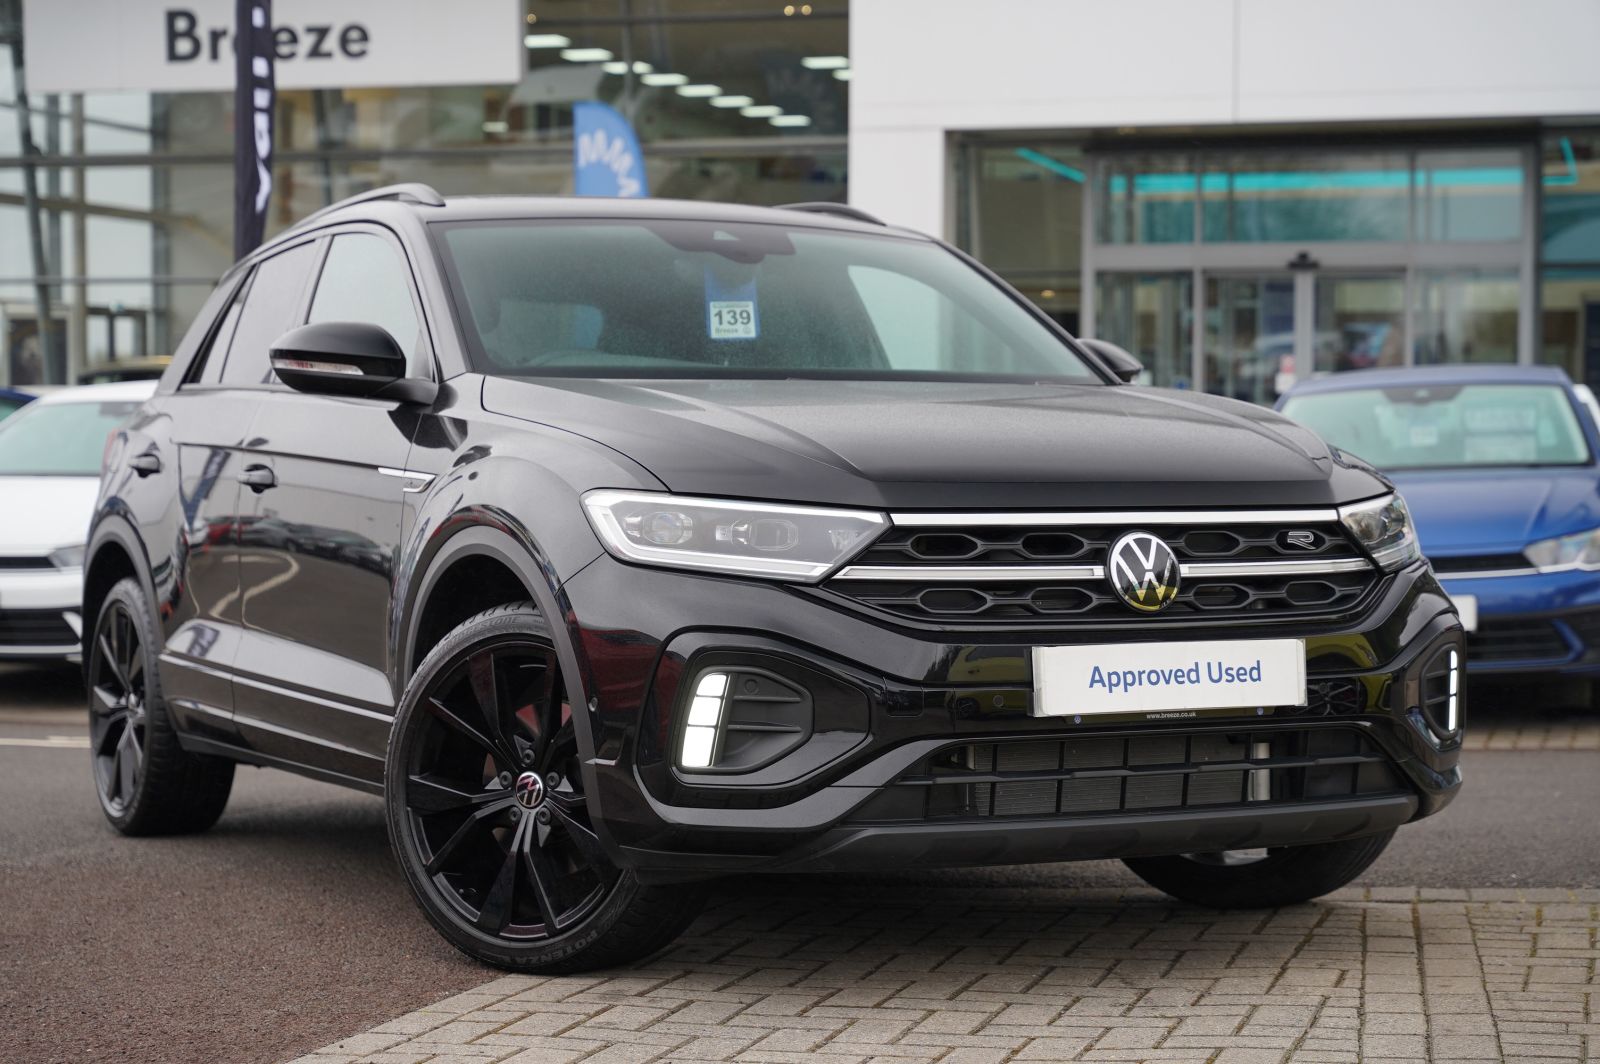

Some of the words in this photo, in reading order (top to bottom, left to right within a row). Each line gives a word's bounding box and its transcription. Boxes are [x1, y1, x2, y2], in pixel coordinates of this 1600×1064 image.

[166, 9, 370, 62] Breze
[714, 309, 752, 326] 139
[1088, 661, 1201, 693] Approved
[1206, 660, 1262, 684] Used
[1146, 711, 1197, 719] www.breeze.co.uk
